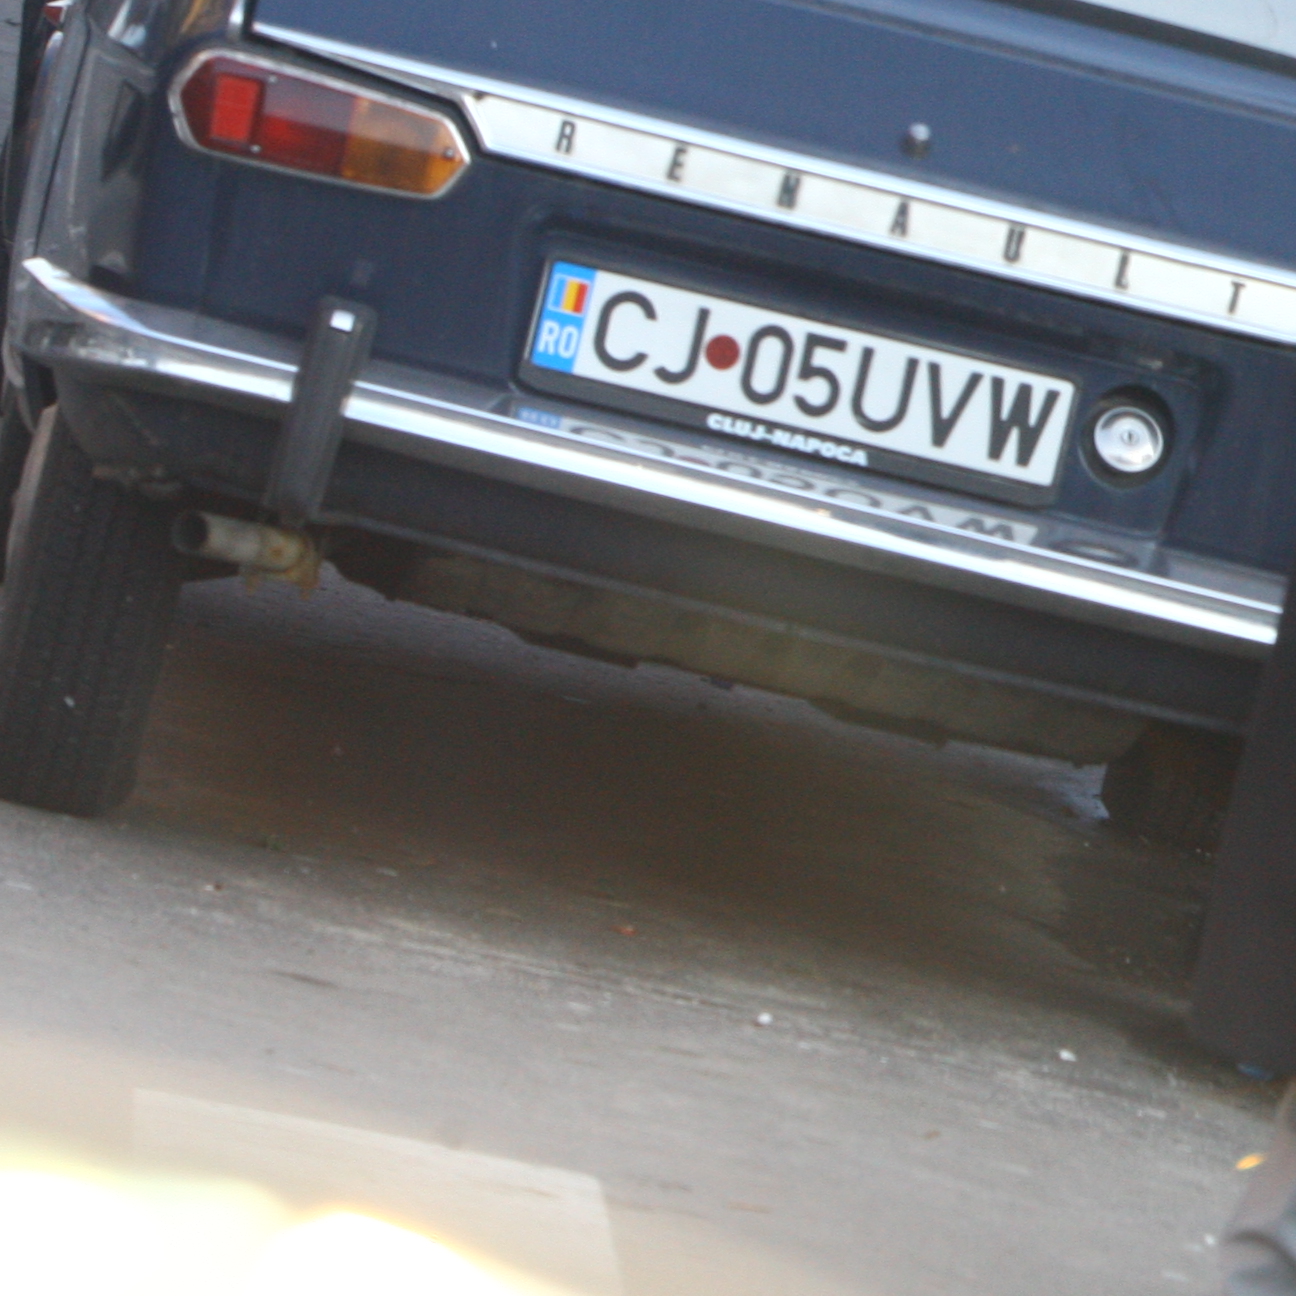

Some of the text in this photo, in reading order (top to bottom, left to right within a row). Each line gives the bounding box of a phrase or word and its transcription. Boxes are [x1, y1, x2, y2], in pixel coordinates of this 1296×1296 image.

[555, 120, 1246, 315] RENAULT
[537, 319, 579, 359] RO
[706, 412, 869, 467] CLUJ-NAPOCA
